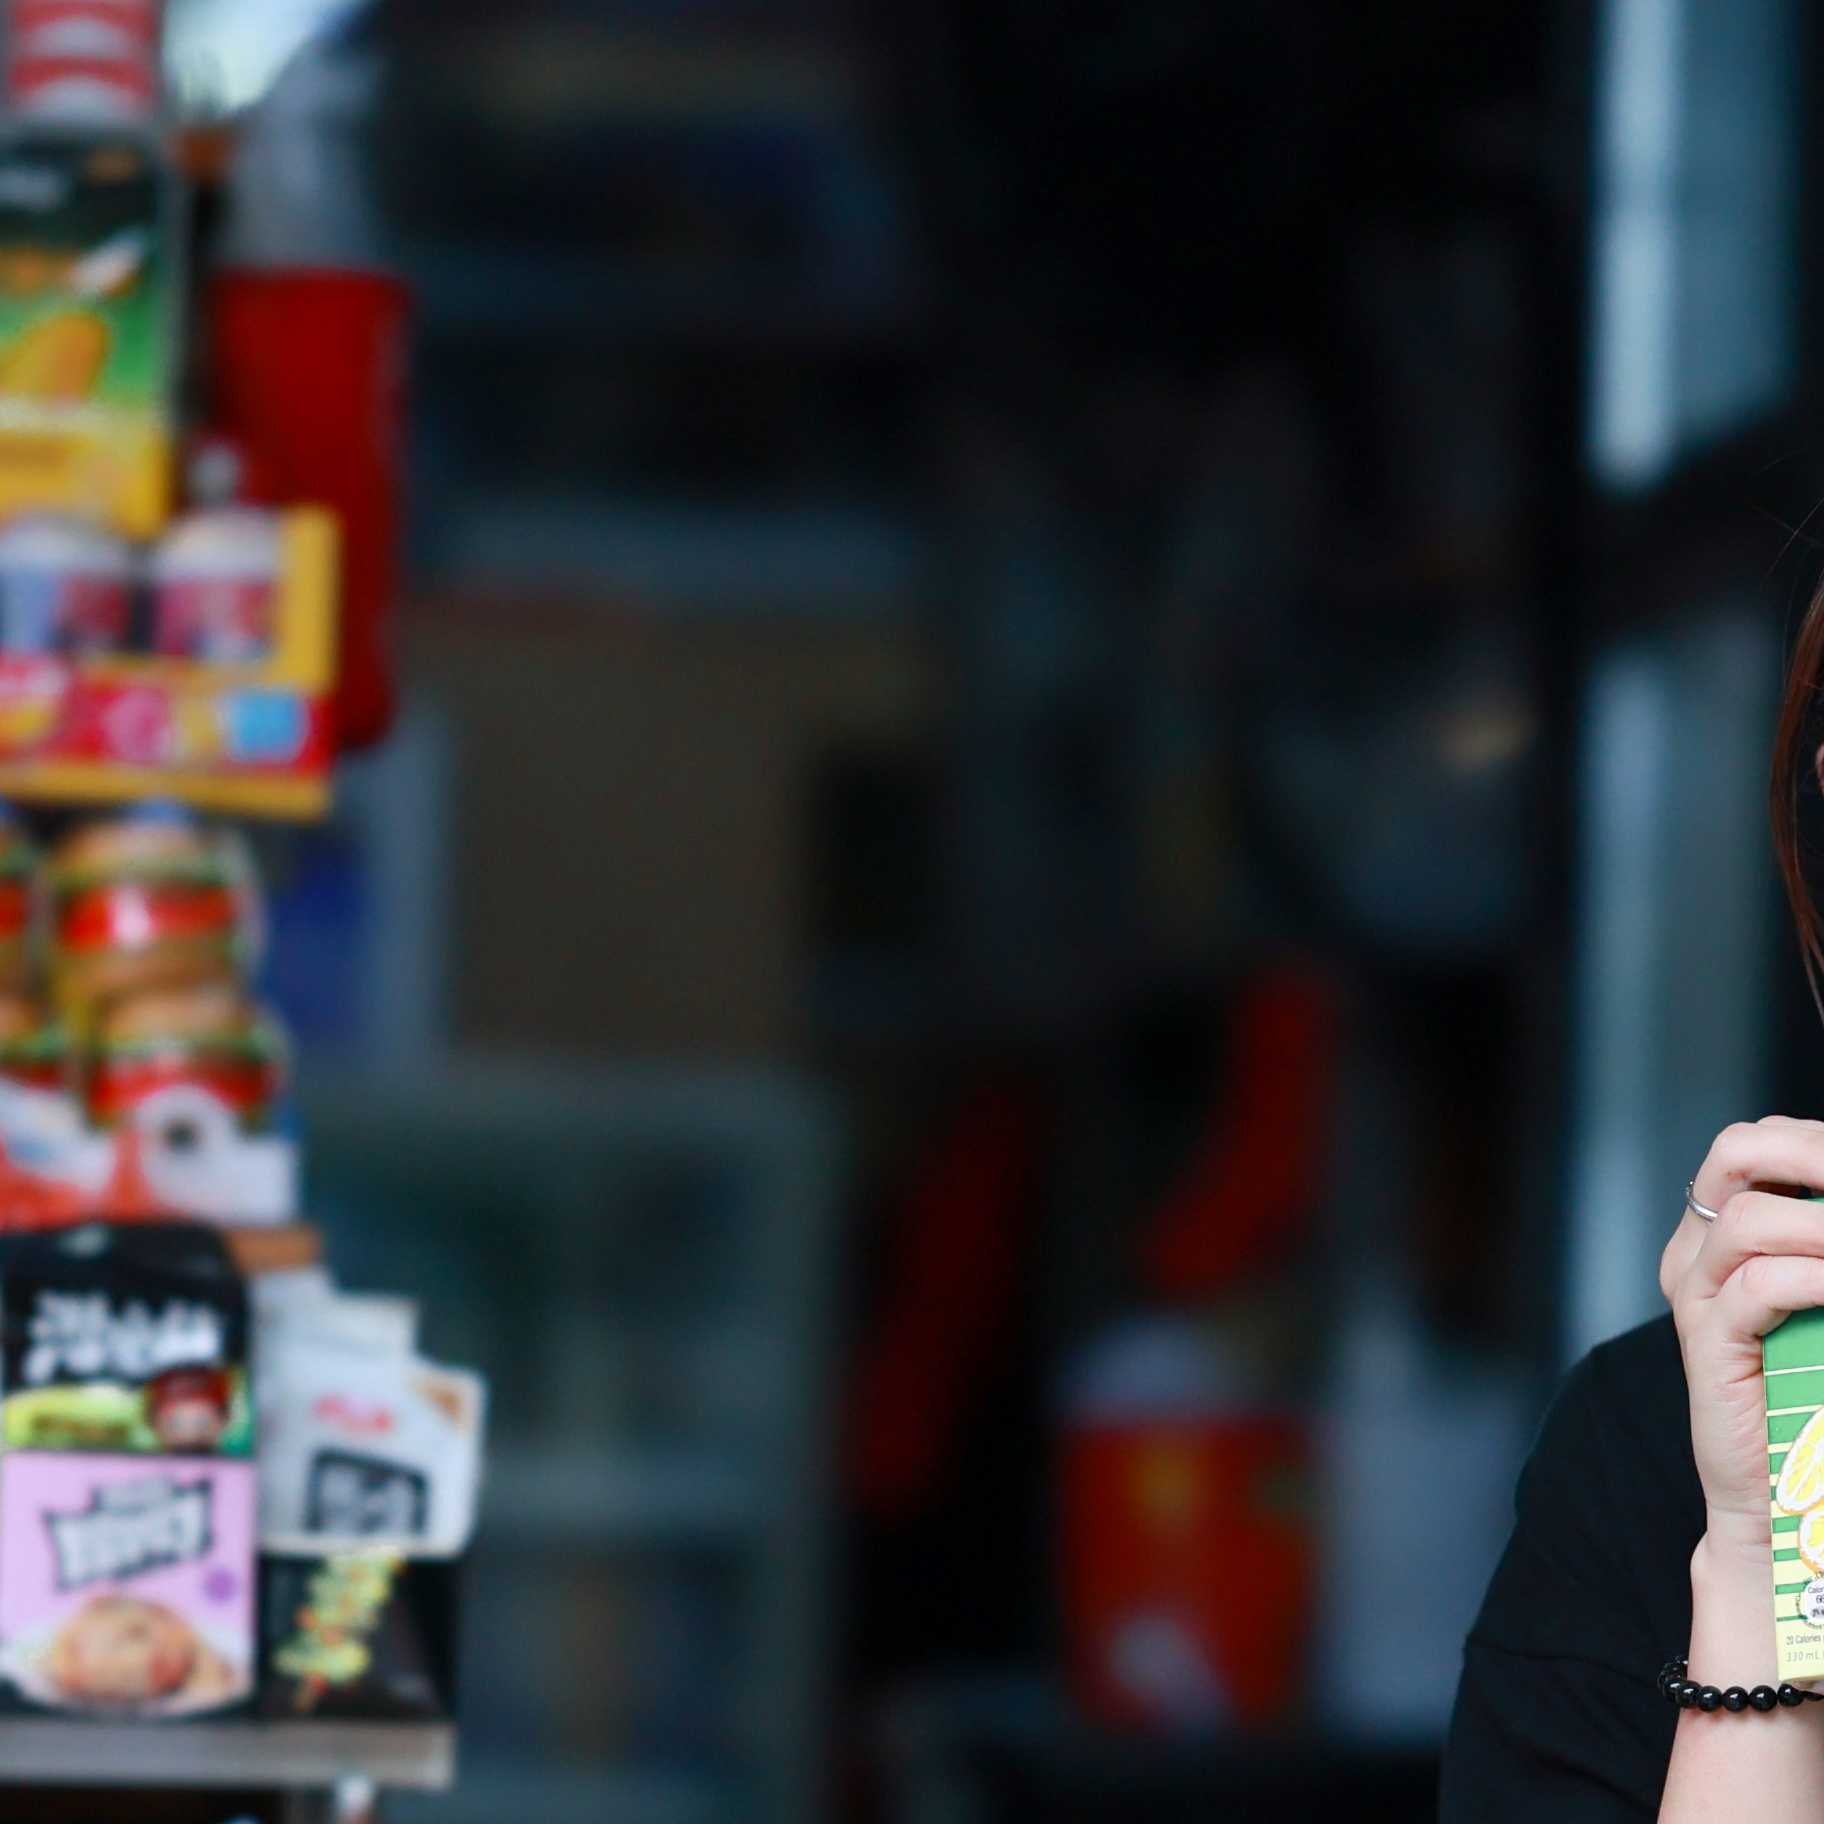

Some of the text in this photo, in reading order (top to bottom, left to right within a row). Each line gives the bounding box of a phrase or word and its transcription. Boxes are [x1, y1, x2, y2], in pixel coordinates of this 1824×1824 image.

[1795, 1633, 1821, 1644] Calories
[1786, 1651, 1804, 1662] 330
[1805, 1649, 1820, 1661] mL
